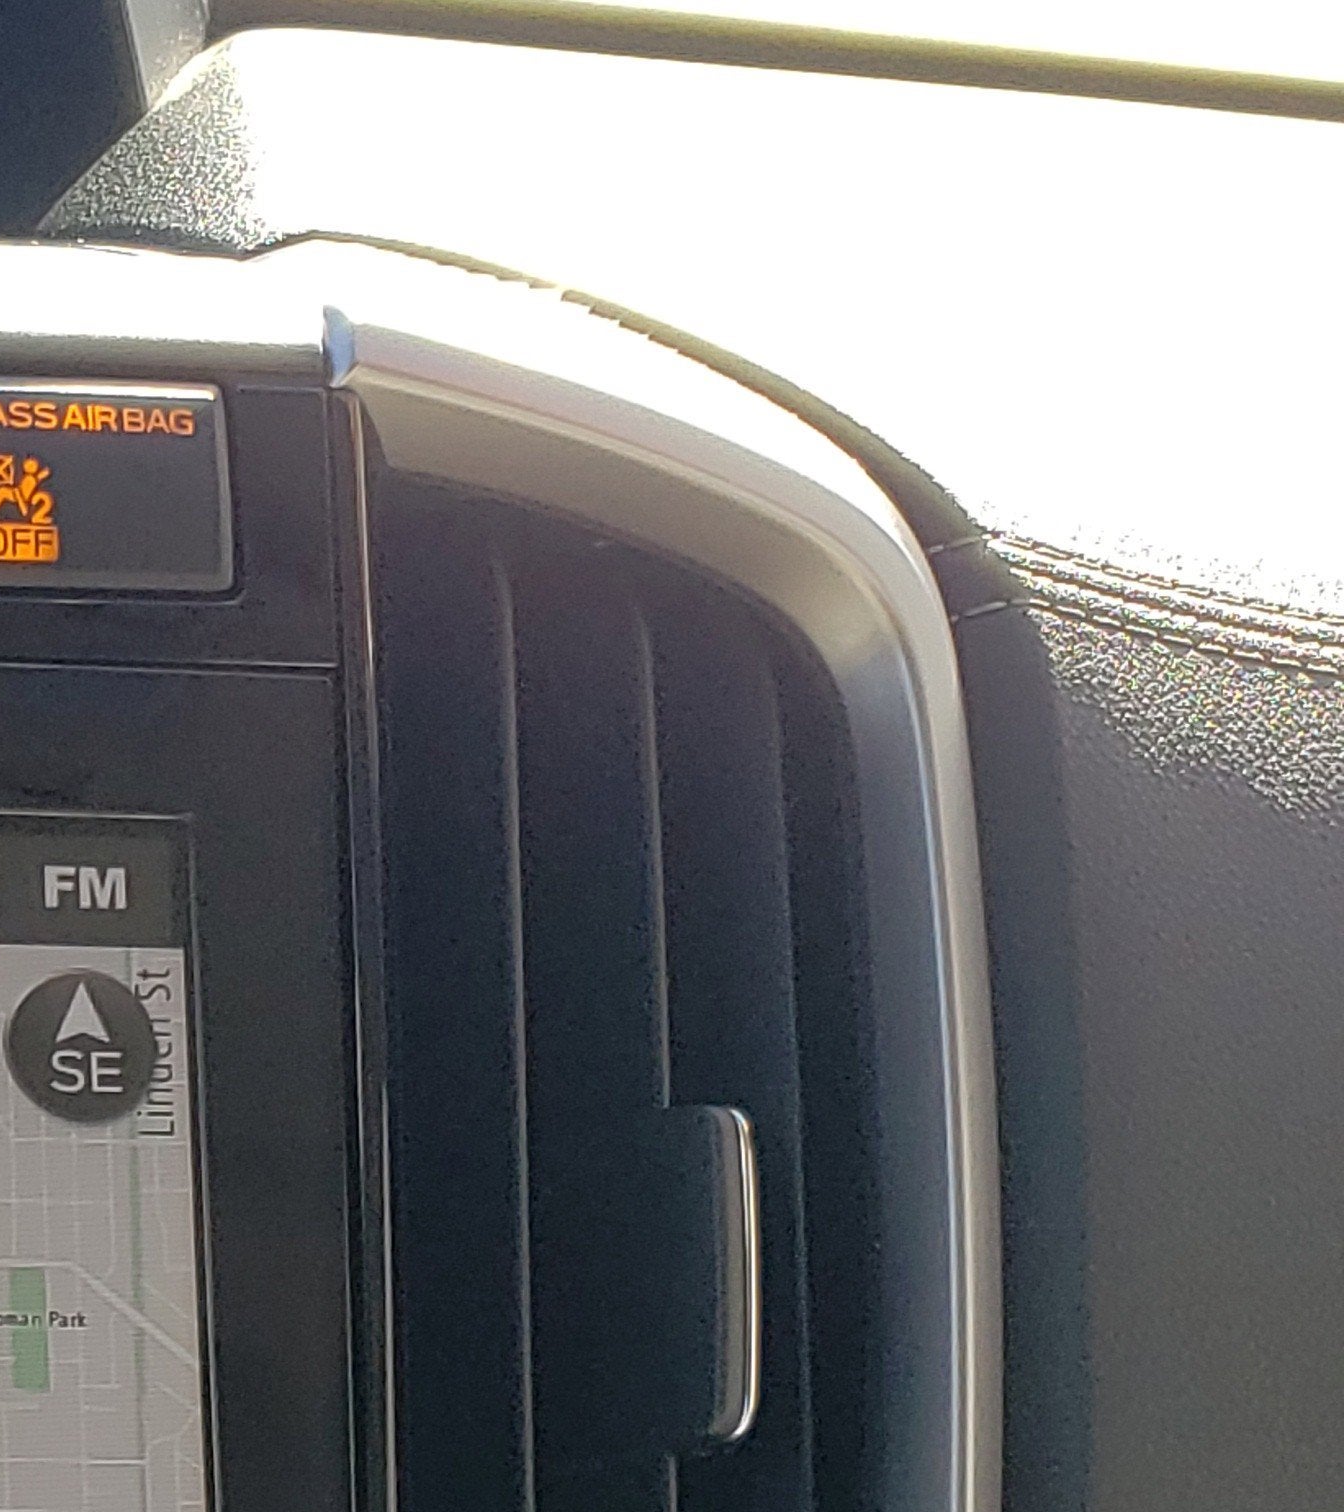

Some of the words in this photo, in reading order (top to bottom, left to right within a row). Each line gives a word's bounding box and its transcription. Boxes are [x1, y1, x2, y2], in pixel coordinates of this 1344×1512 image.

[43, 865, 128, 911] FM
[134, 968, 173, 1002] St
[50, 1050, 124, 1093] SE
[48, 1311, 89, 1328] Park
